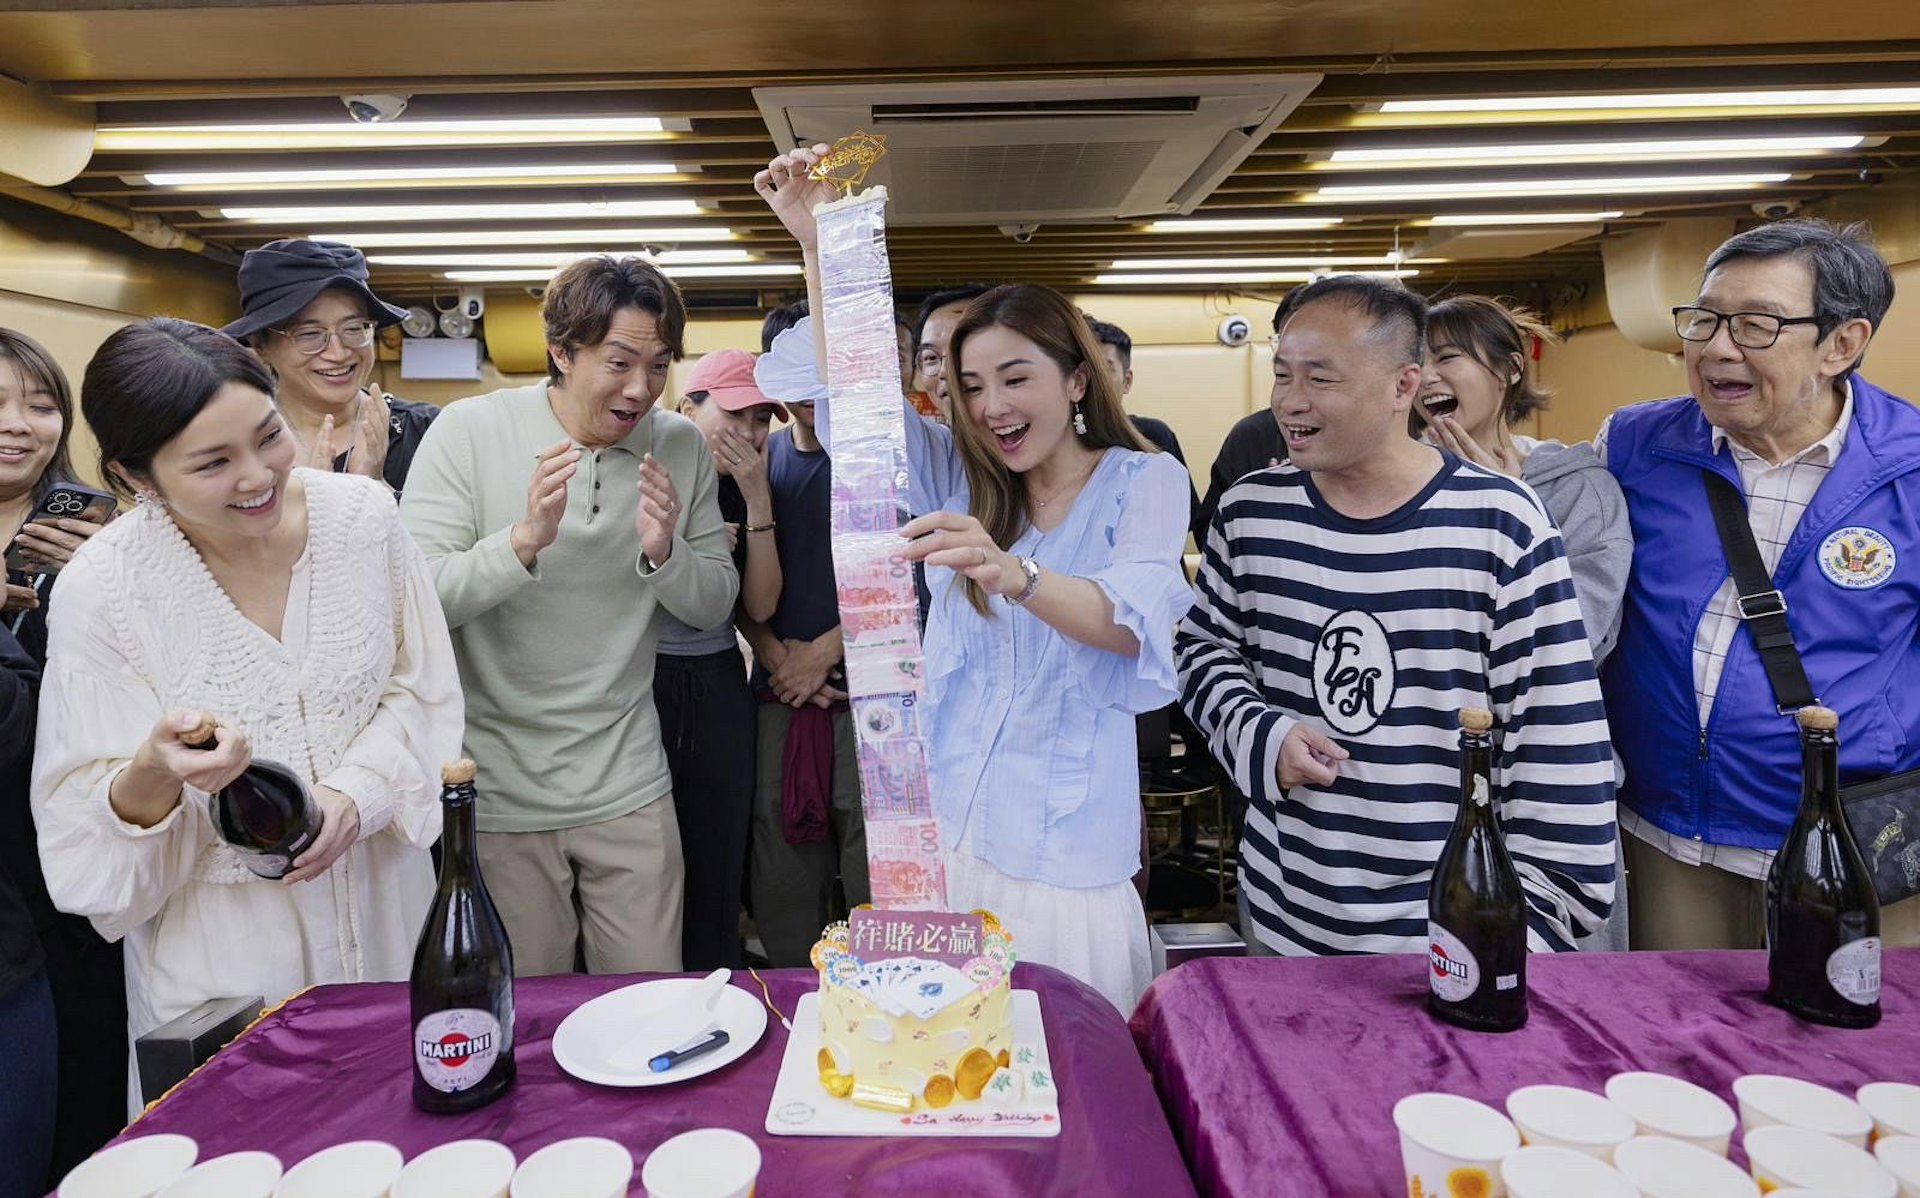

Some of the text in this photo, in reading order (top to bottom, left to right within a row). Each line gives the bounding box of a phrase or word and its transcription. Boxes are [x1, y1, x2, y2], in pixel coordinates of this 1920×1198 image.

[1829, 528, 1891, 549] NATURAL BEAUTY
[1823, 558, 1844, 580] PACIFIC
[901, 692, 915, 708] 10
[919, 821, 939, 854] 100
[855, 918, 979, 955] 祥賭必贏
[422, 1033, 490, 1058] MARTINI
